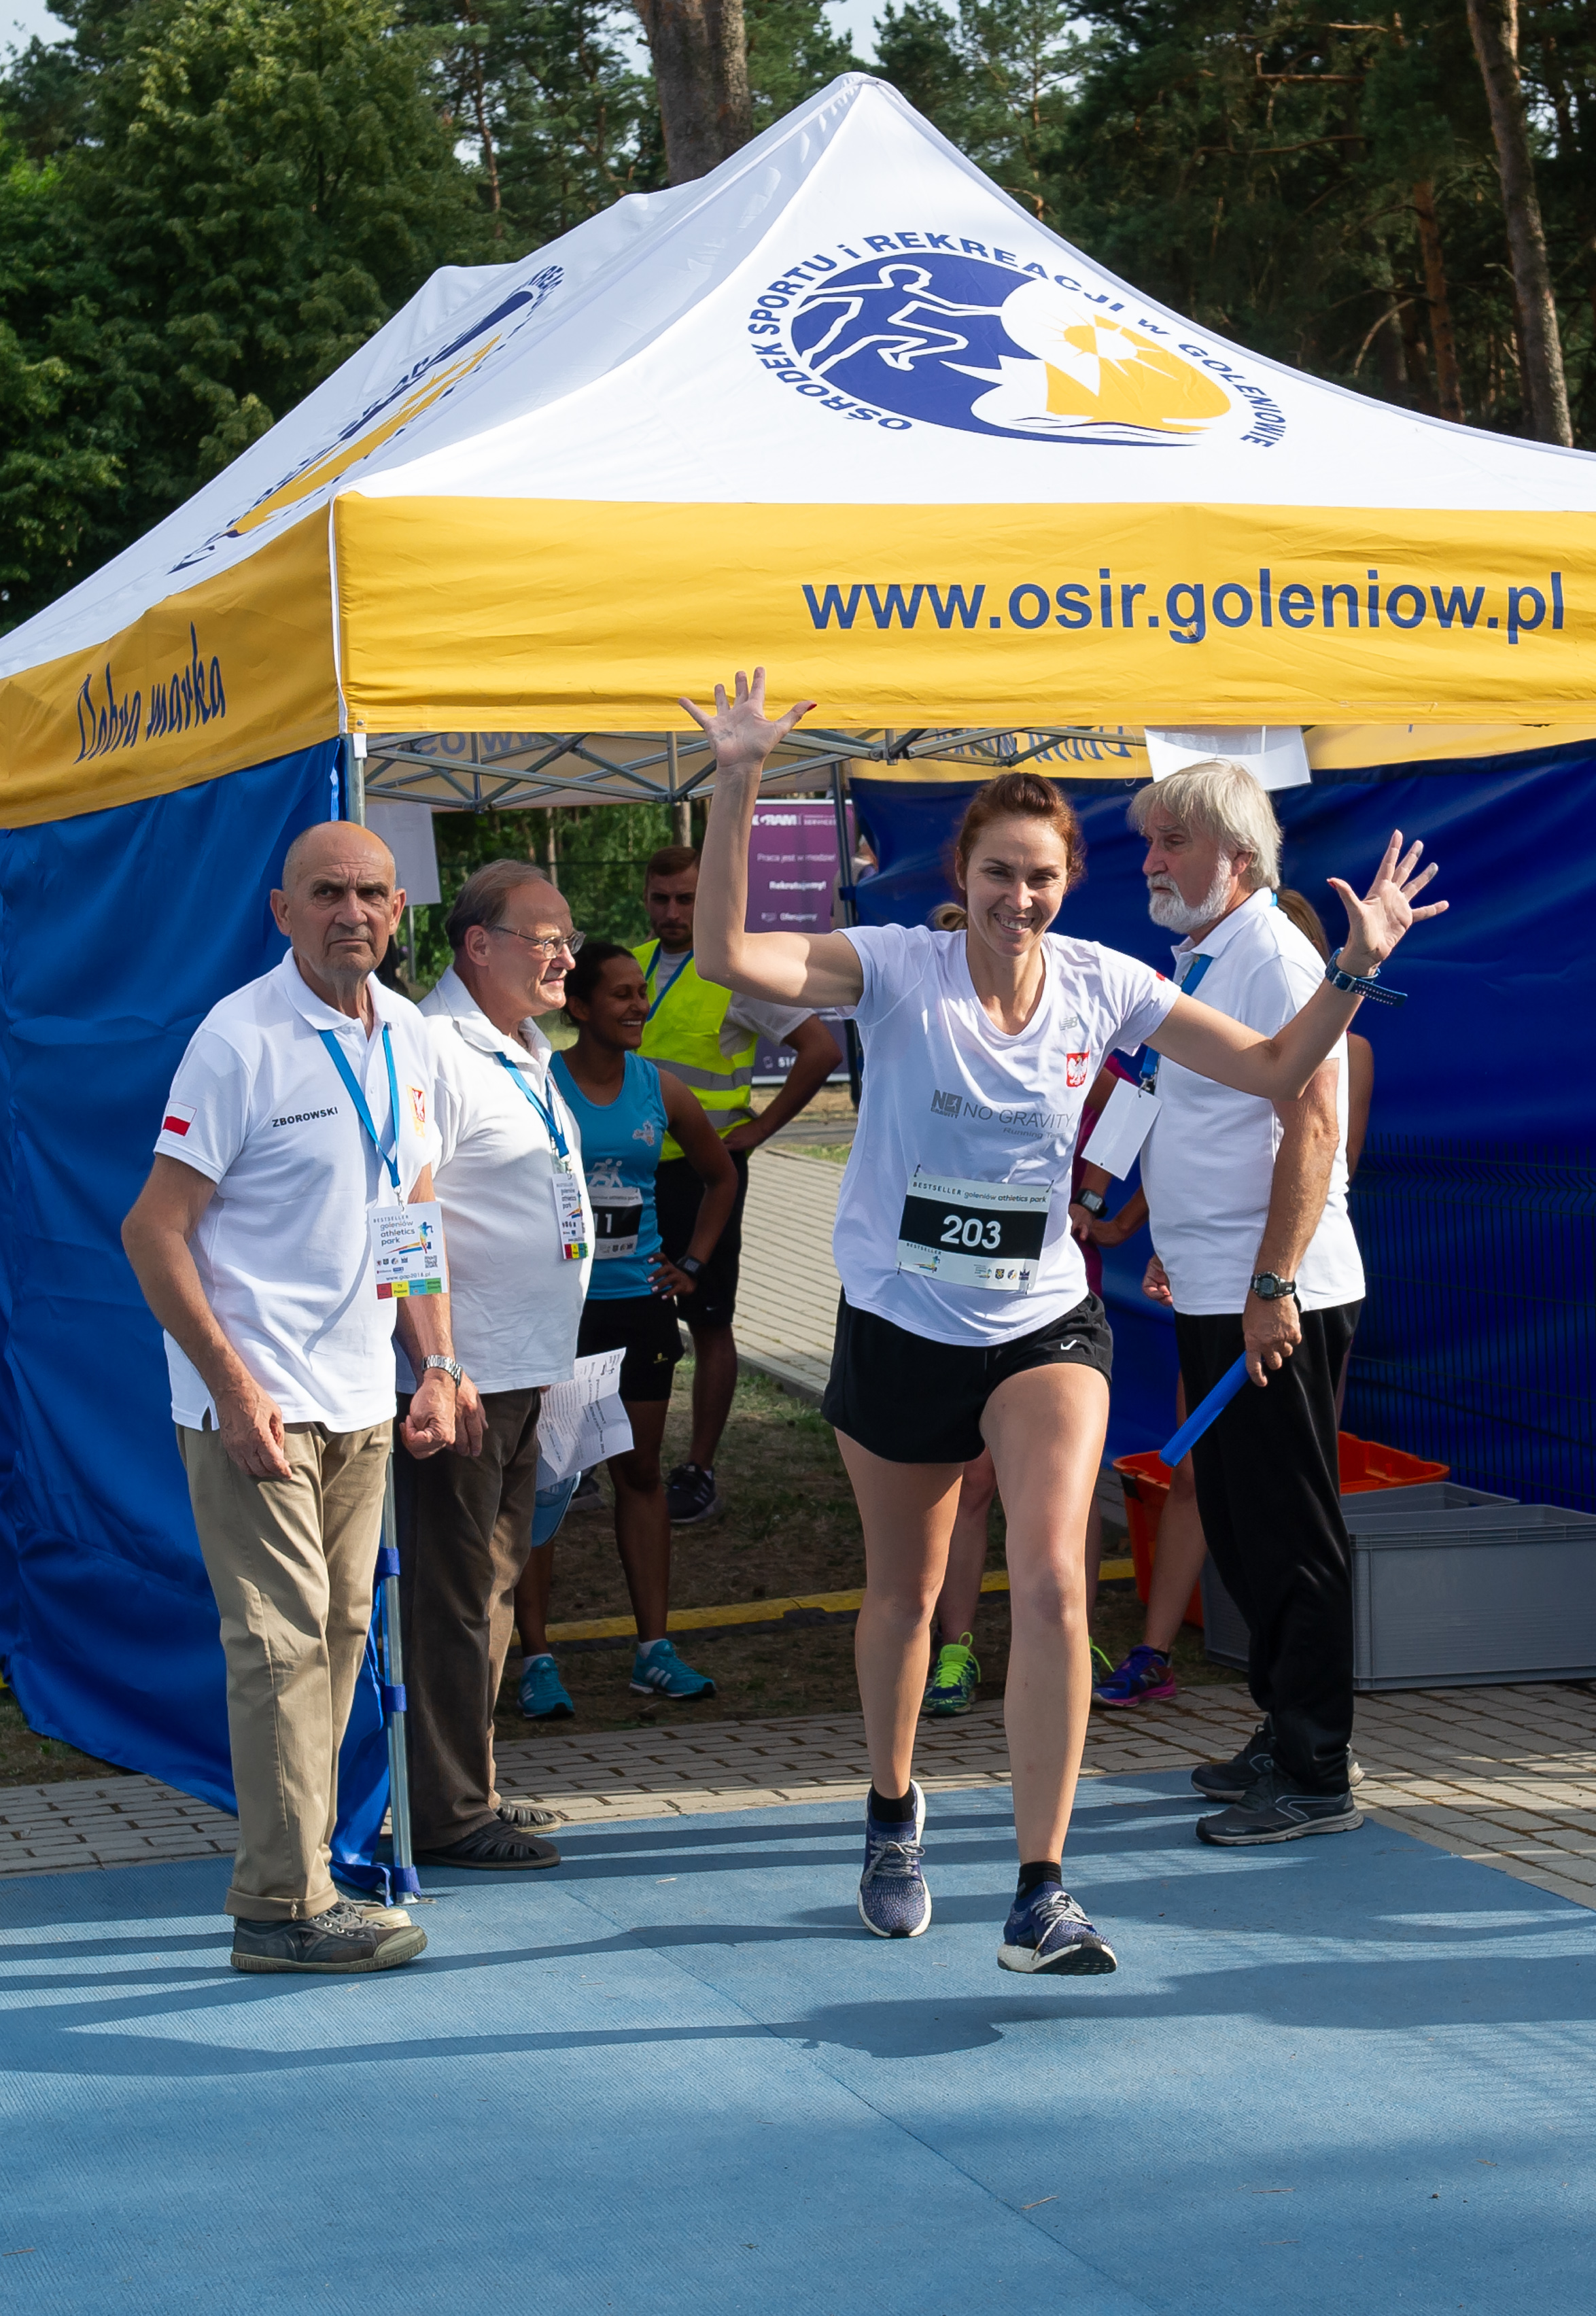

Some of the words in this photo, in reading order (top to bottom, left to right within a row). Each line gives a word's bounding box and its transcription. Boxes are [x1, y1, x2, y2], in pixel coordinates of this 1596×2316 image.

[837, 244, 860, 260] i
[863, 231, 1125, 312] REKREACJI
[748, 254, 838, 336] SPORTU
[750, 341, 913, 431] OŚRODEK
[1178, 342, 1287, 449] GOLENIOWIE
[802, 568, 1563, 644] www.osir.goleniow.pl
[72, 662, 141, 765] Dobra
[145, 621, 226, 742] marka
[272, 1106, 339, 1128] ZBOROWSKI
[963, 1102, 992, 1120] NO
[999, 1109, 1074, 1128] GRAVITY
[1003, 1127, 1043, 1139] Running
[912, 1181, 961, 1196] BESTSELLER
[964, 1192, 996, 1200] goleniów
[998, 1194, 1028, 1203] athletics
[373, 1215, 409, 1223] BESTSELLER
[380, 1221, 414, 1231] goleniów
[381, 1228, 415, 1238] athletics
[381, 1237, 400, 1246] park
[940, 1215, 1001, 1249] 203
[906, 1243, 941, 1256] BESTSELLER
